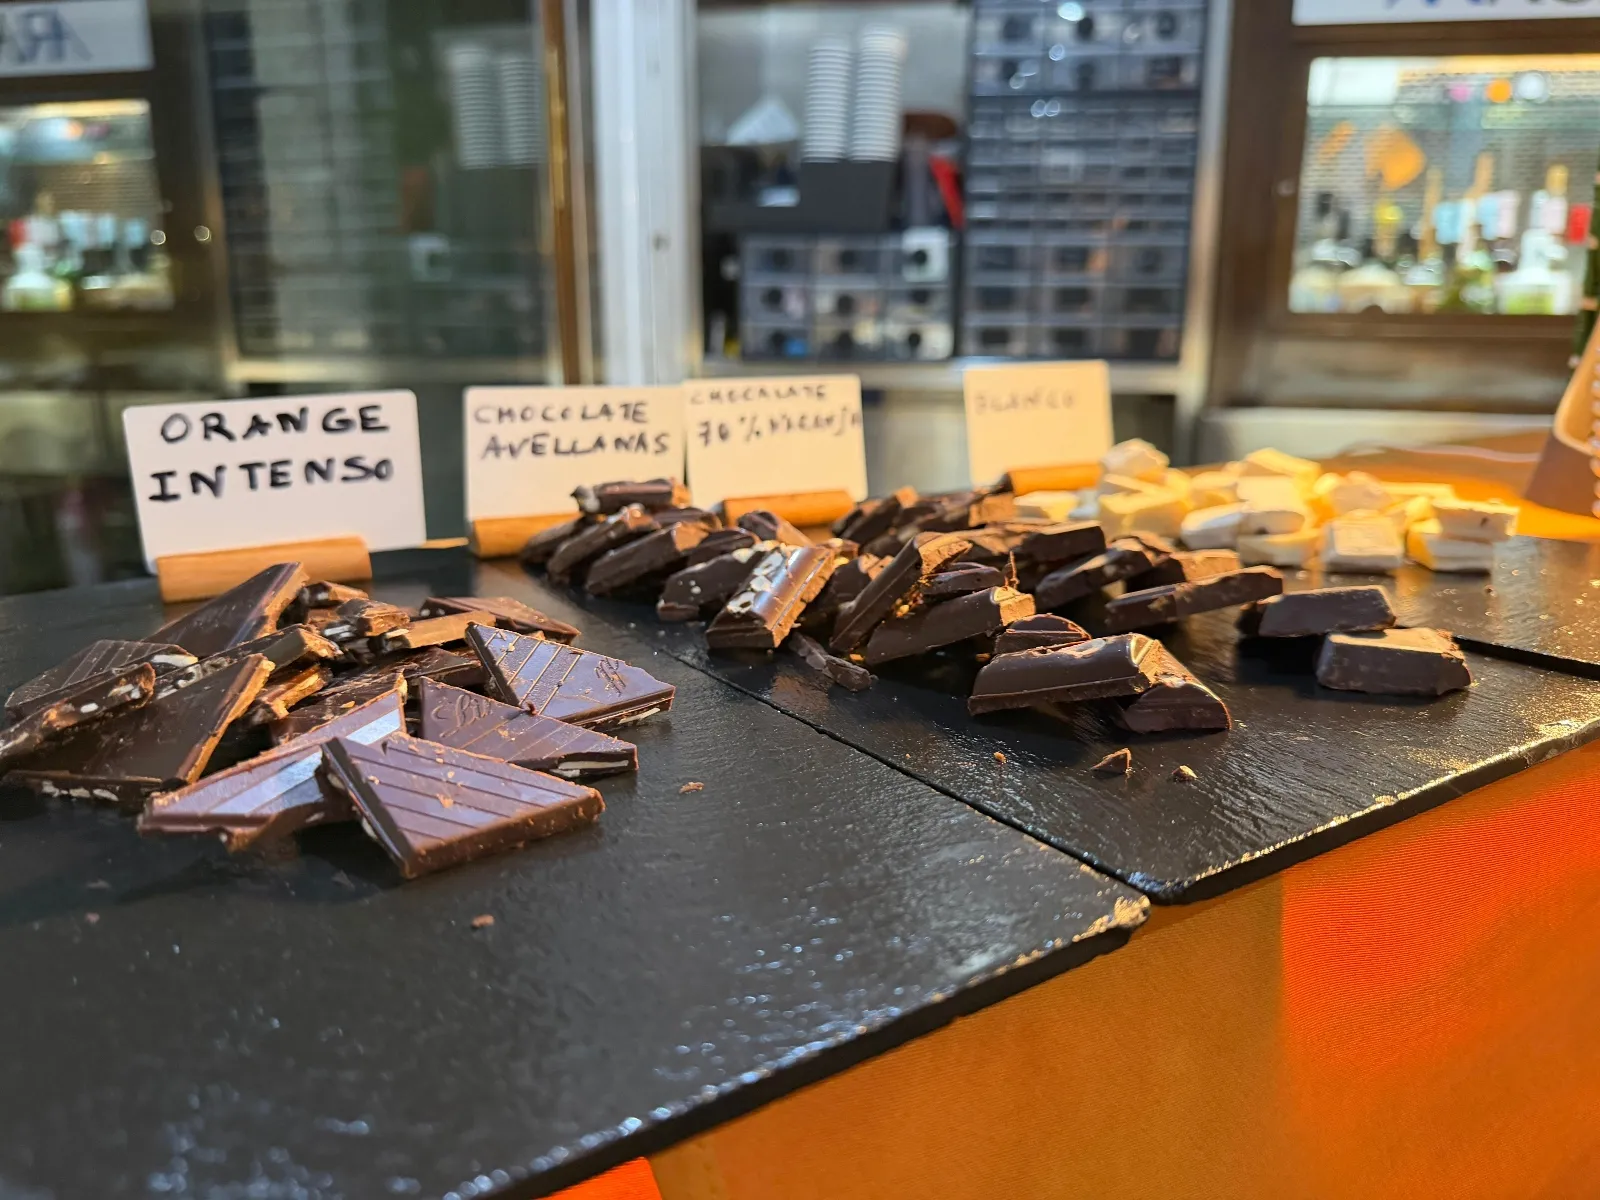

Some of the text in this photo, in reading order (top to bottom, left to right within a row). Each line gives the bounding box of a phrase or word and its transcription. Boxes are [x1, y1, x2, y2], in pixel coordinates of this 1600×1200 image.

[160, 405, 390, 443] ORANGE
[474, 402, 649, 424] CHOCOLATE
[480, 432, 670, 460] AVELLANAS
[148, 456, 394, 502] INTENSO
